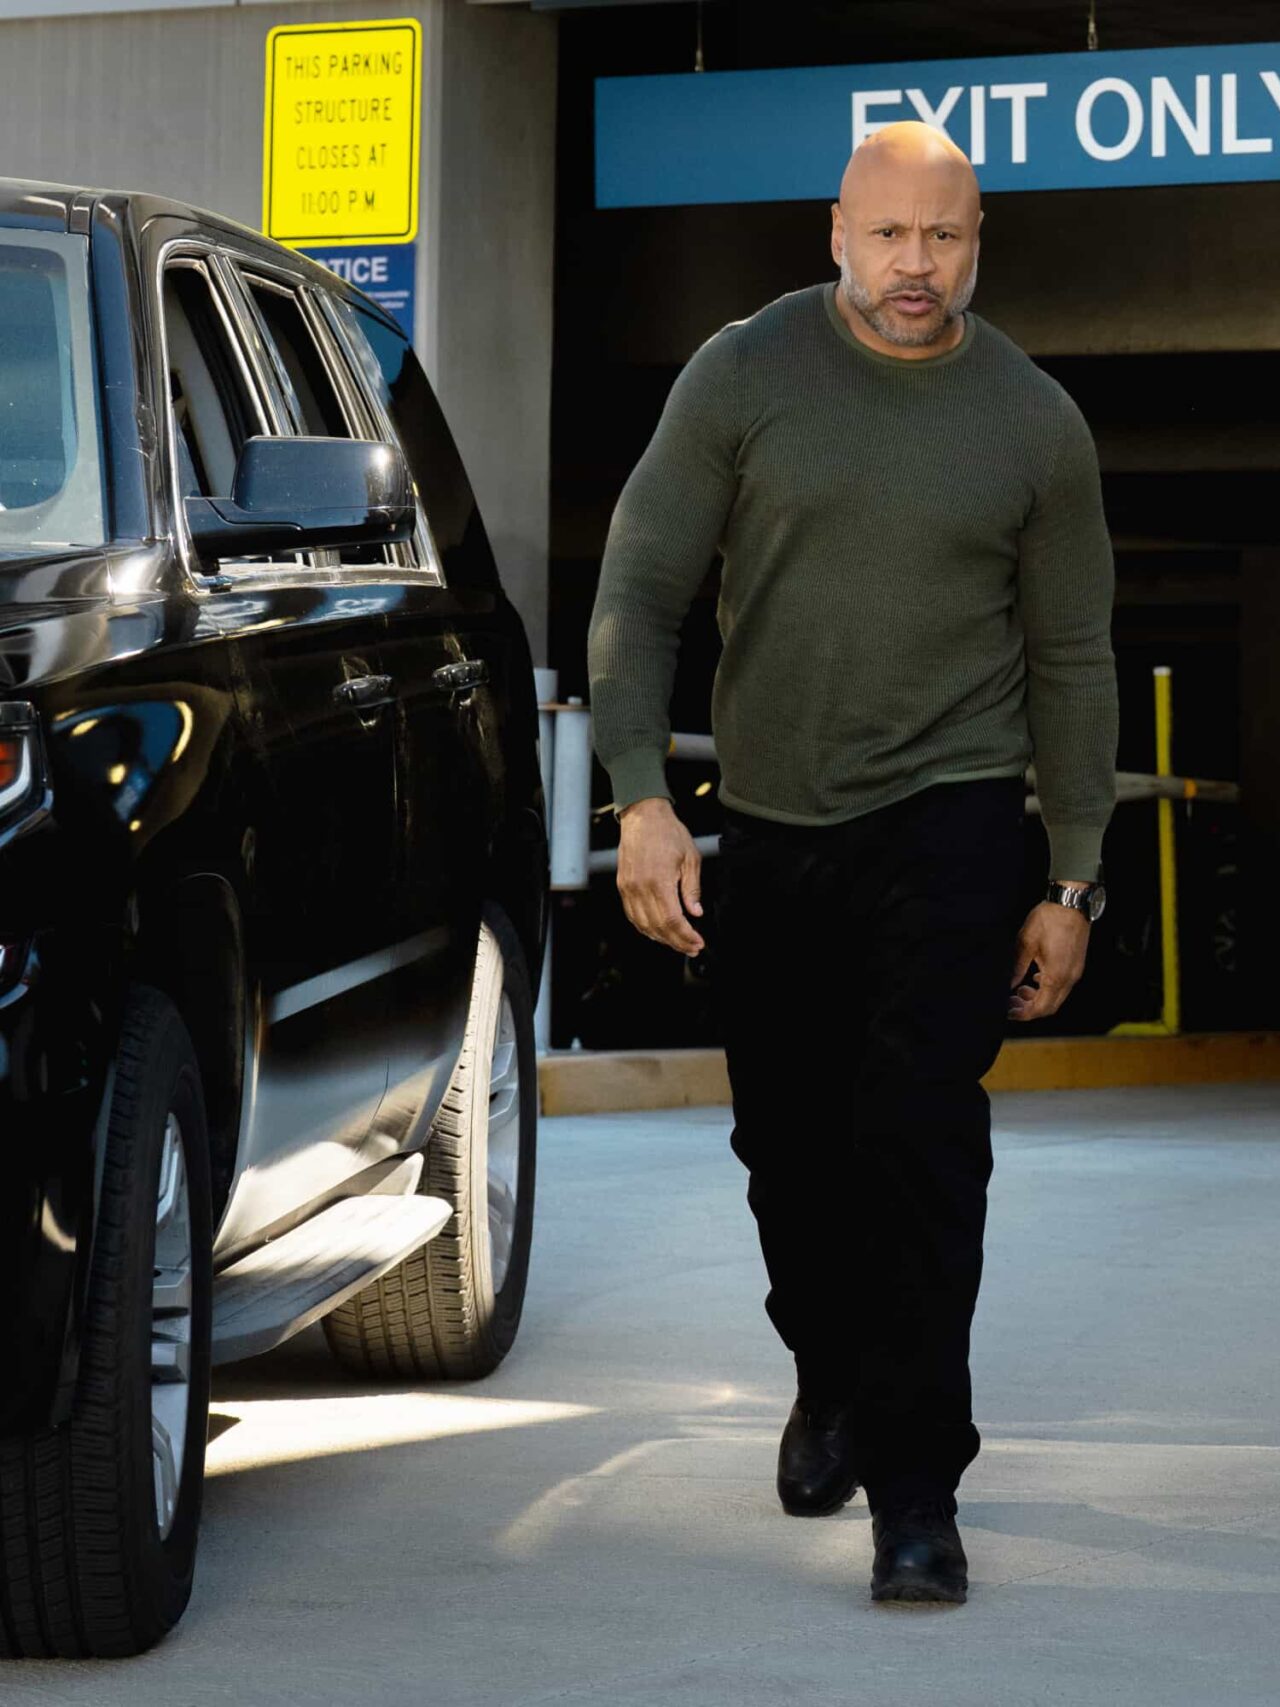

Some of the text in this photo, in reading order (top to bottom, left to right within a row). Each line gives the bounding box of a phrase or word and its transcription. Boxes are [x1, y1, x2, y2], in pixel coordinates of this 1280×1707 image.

[286, 51, 403, 79] THIS PARKING
[294, 97, 393, 124] STRUCTURE
[852, 82, 1048, 166] EXIT
[296, 143, 388, 170] CLOSES AT
[318, 256, 389, 283] TICE
